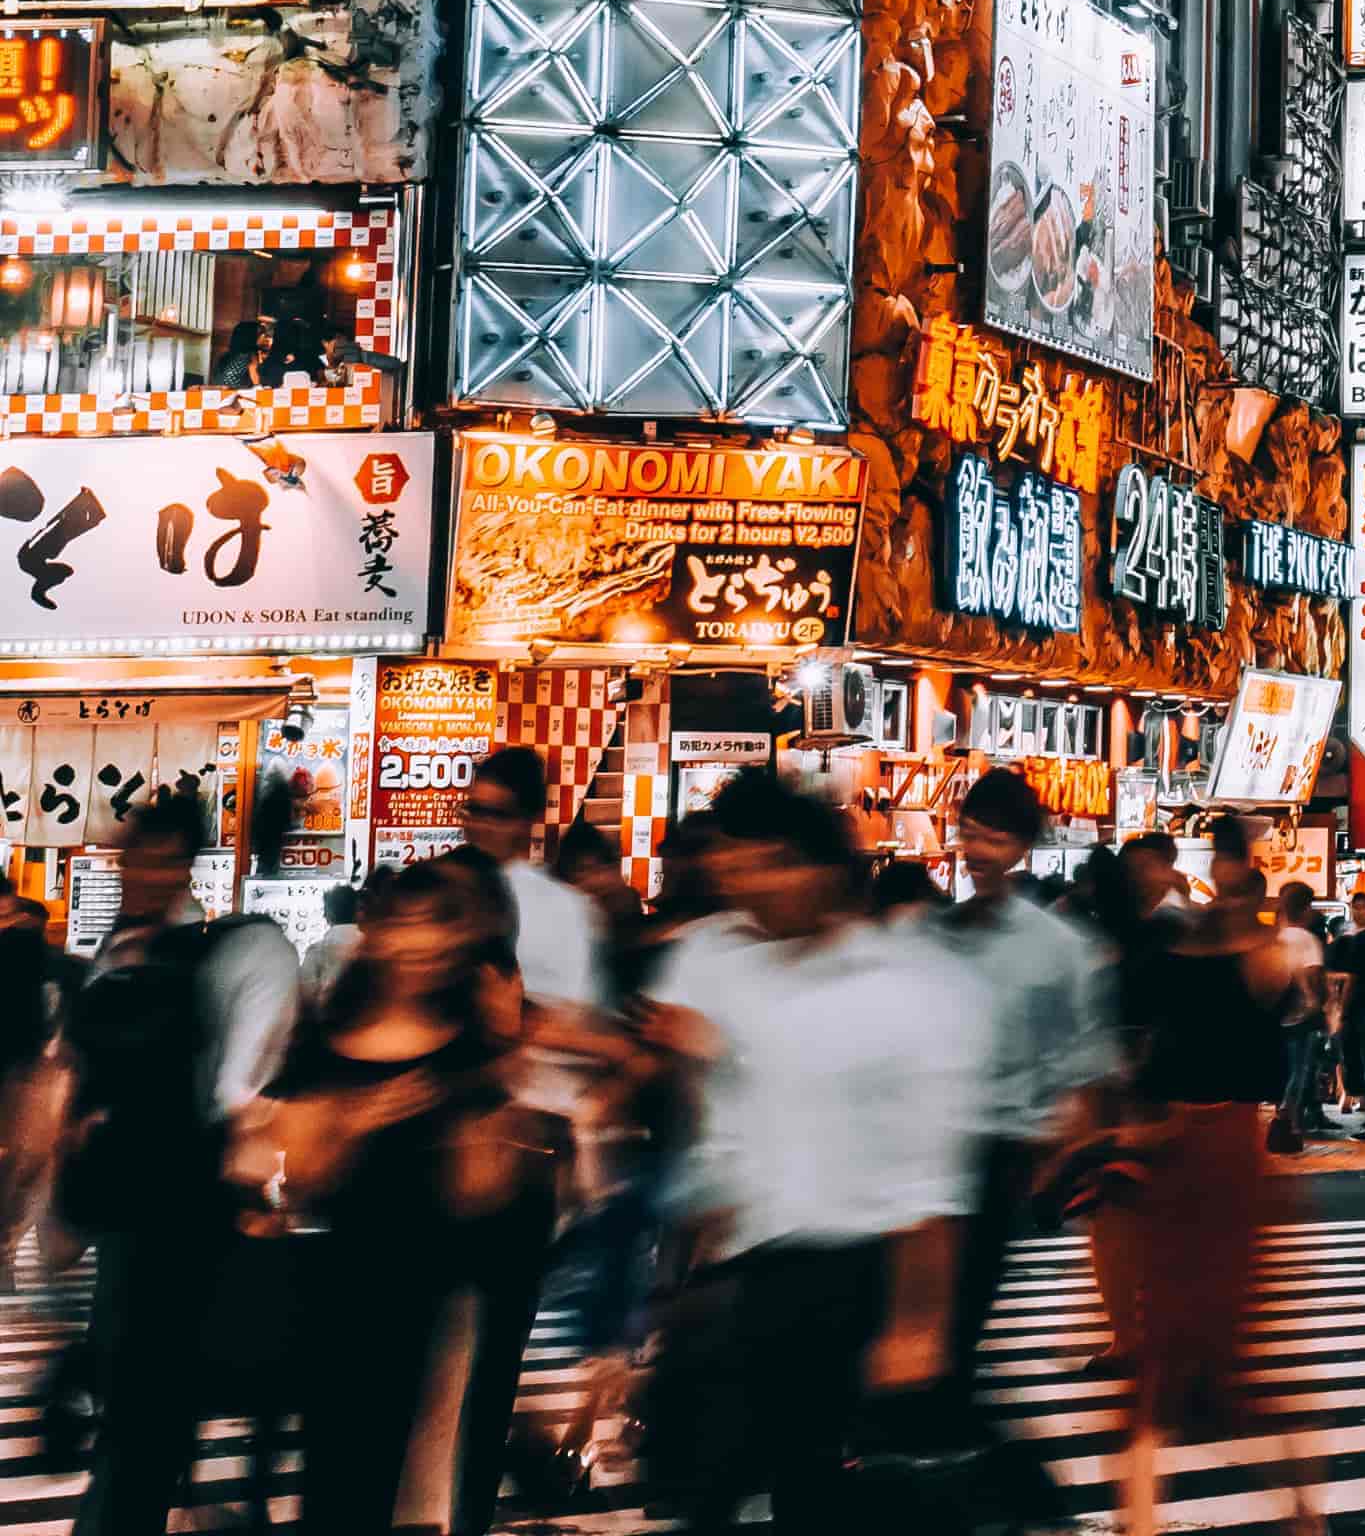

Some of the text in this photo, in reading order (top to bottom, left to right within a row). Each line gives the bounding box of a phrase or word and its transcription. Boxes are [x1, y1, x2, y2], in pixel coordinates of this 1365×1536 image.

[474, 443, 862, 497] OKONOMI YAKI
[736, 505, 857, 525] Free-Flowing
[624, 521, 854, 545] Drinks for 2 hours ¥2,500
[182, 606, 415, 627] UDON & SOBA Eat standing
[679, 739, 766, 753] 防犯カメラ作動中
[379, 754, 473, 790] 2,500
